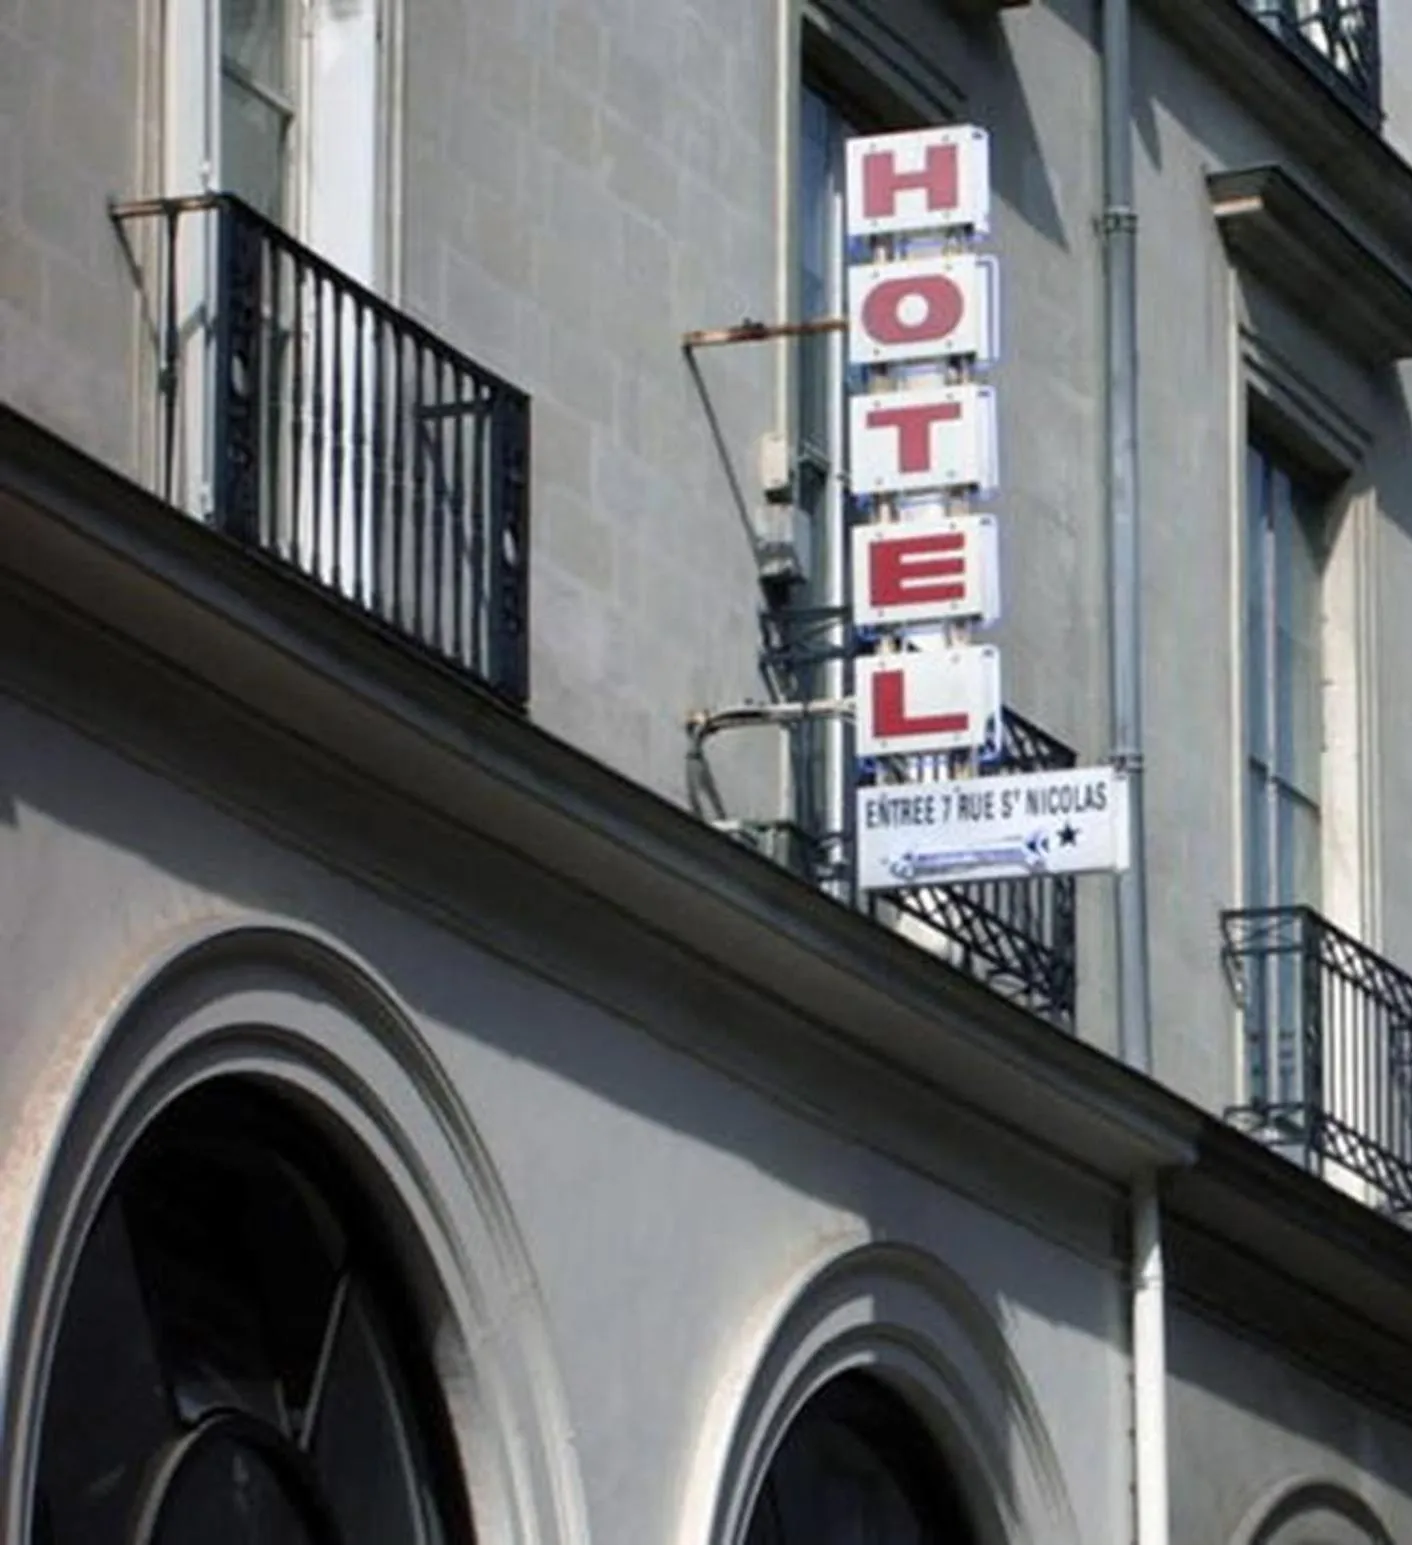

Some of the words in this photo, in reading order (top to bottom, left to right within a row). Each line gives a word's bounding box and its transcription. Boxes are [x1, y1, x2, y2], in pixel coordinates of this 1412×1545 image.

[861, 144, 969, 739] HOTEL
[866, 794, 935, 828] ENTREE
[941, 795, 952, 823] 7
[957, 790, 996, 822] RUE
[1026, 781, 1107, 816] NICOLAS
